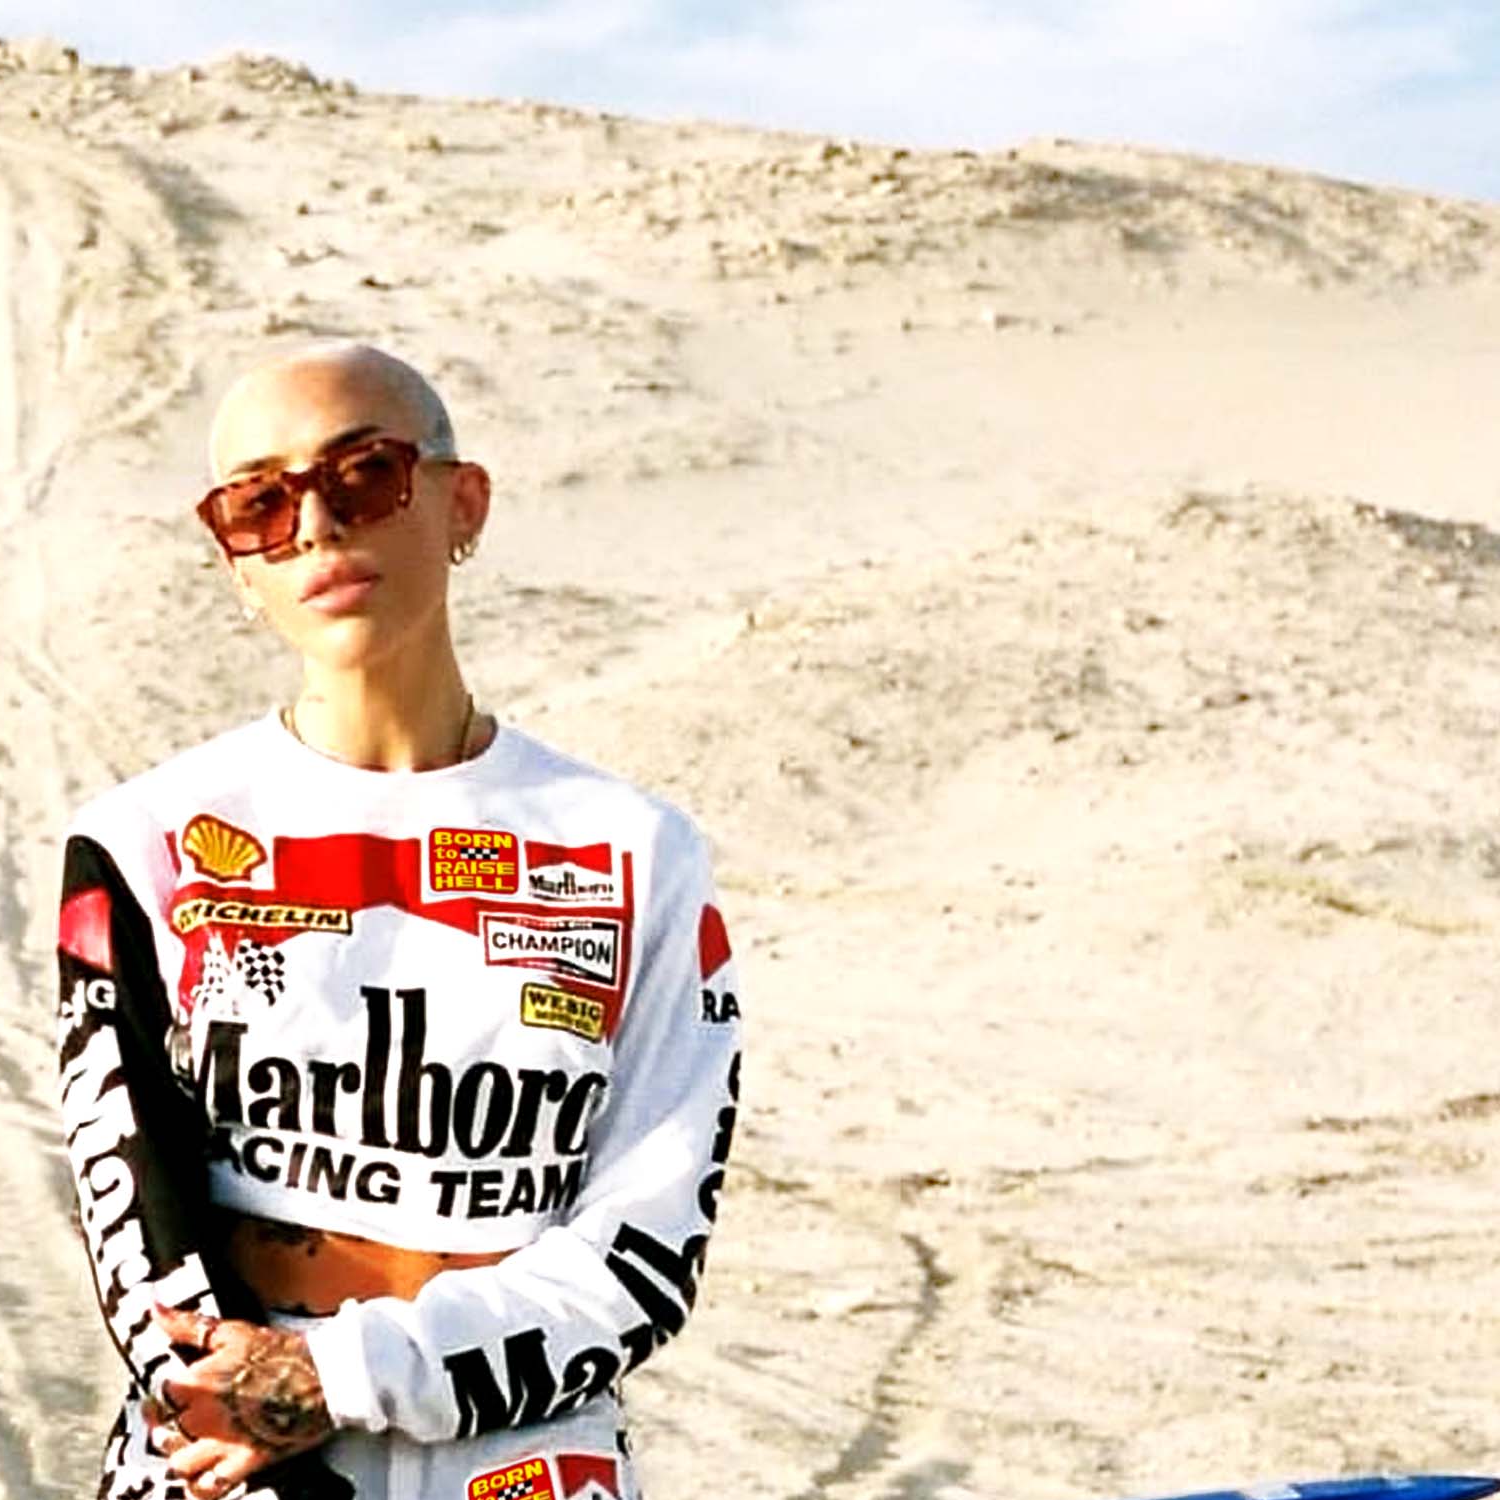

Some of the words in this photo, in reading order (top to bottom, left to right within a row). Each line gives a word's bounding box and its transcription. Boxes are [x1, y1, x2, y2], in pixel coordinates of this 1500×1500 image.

[433, 830, 513, 849] BORN
[434, 847, 457, 860] to
[435, 861, 515, 876] RAISE
[435, 875, 515, 891] HELL
[491, 931, 611, 965] CHAMPION
[207, 1127, 400, 1205] ACING
[430, 1159, 583, 1220] TEAM
[471, 1460, 544, 1497] BORN
